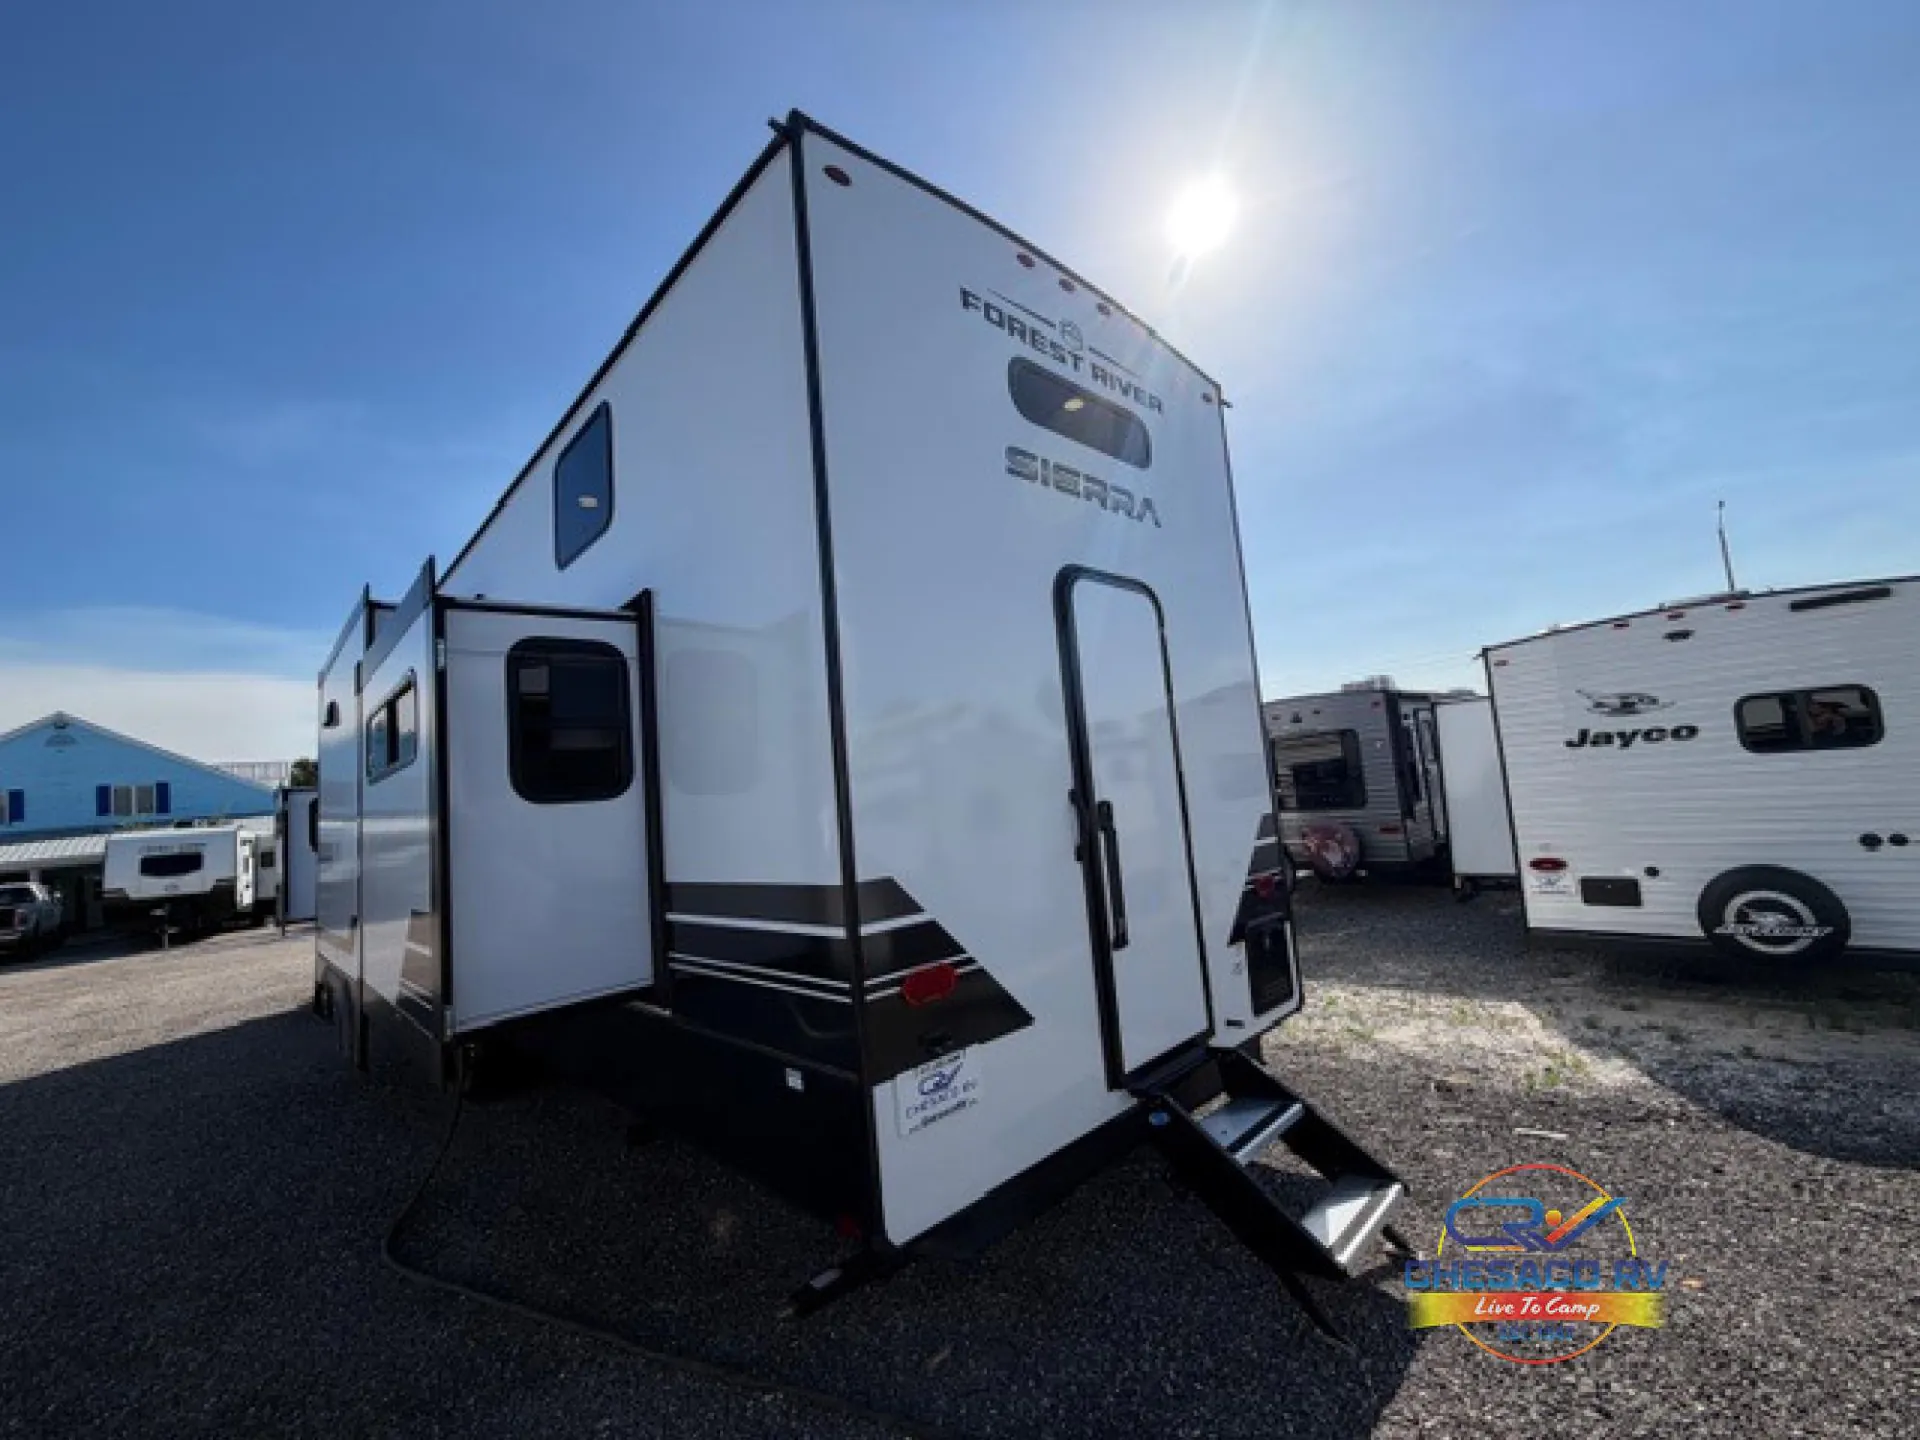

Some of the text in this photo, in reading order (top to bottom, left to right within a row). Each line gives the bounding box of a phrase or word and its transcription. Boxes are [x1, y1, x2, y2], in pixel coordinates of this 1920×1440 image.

[959, 287, 1163, 415] FOREST RIVER
[1005, 445, 1162, 528] SIERRA
[1563, 725, 1700, 750] Jayco
